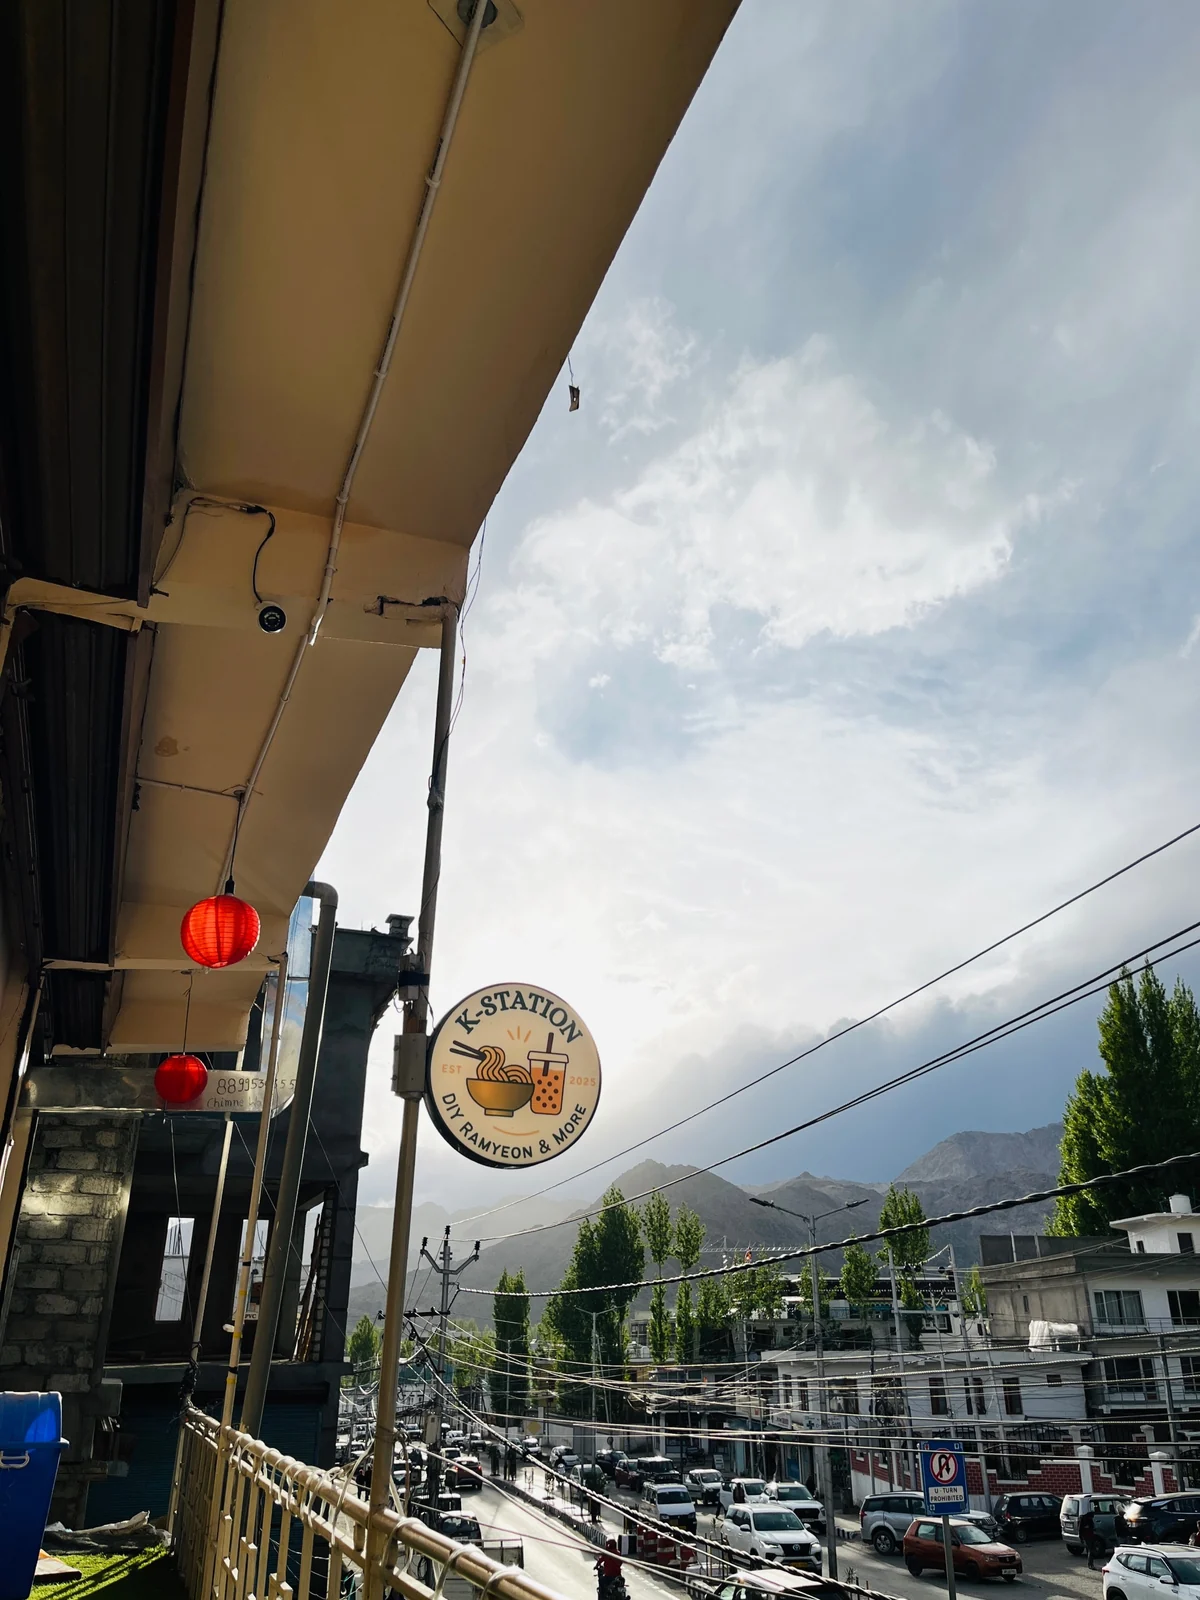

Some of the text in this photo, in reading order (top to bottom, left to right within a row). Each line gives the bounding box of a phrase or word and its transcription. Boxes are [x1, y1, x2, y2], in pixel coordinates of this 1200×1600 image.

[455, 990, 583, 1044] K-STATION
[441, 1063, 463, 1075] EST
[569, 1075, 597, 1087] 2025
[442, 1092, 587, 1159] DIY RAMYEON & MORE
